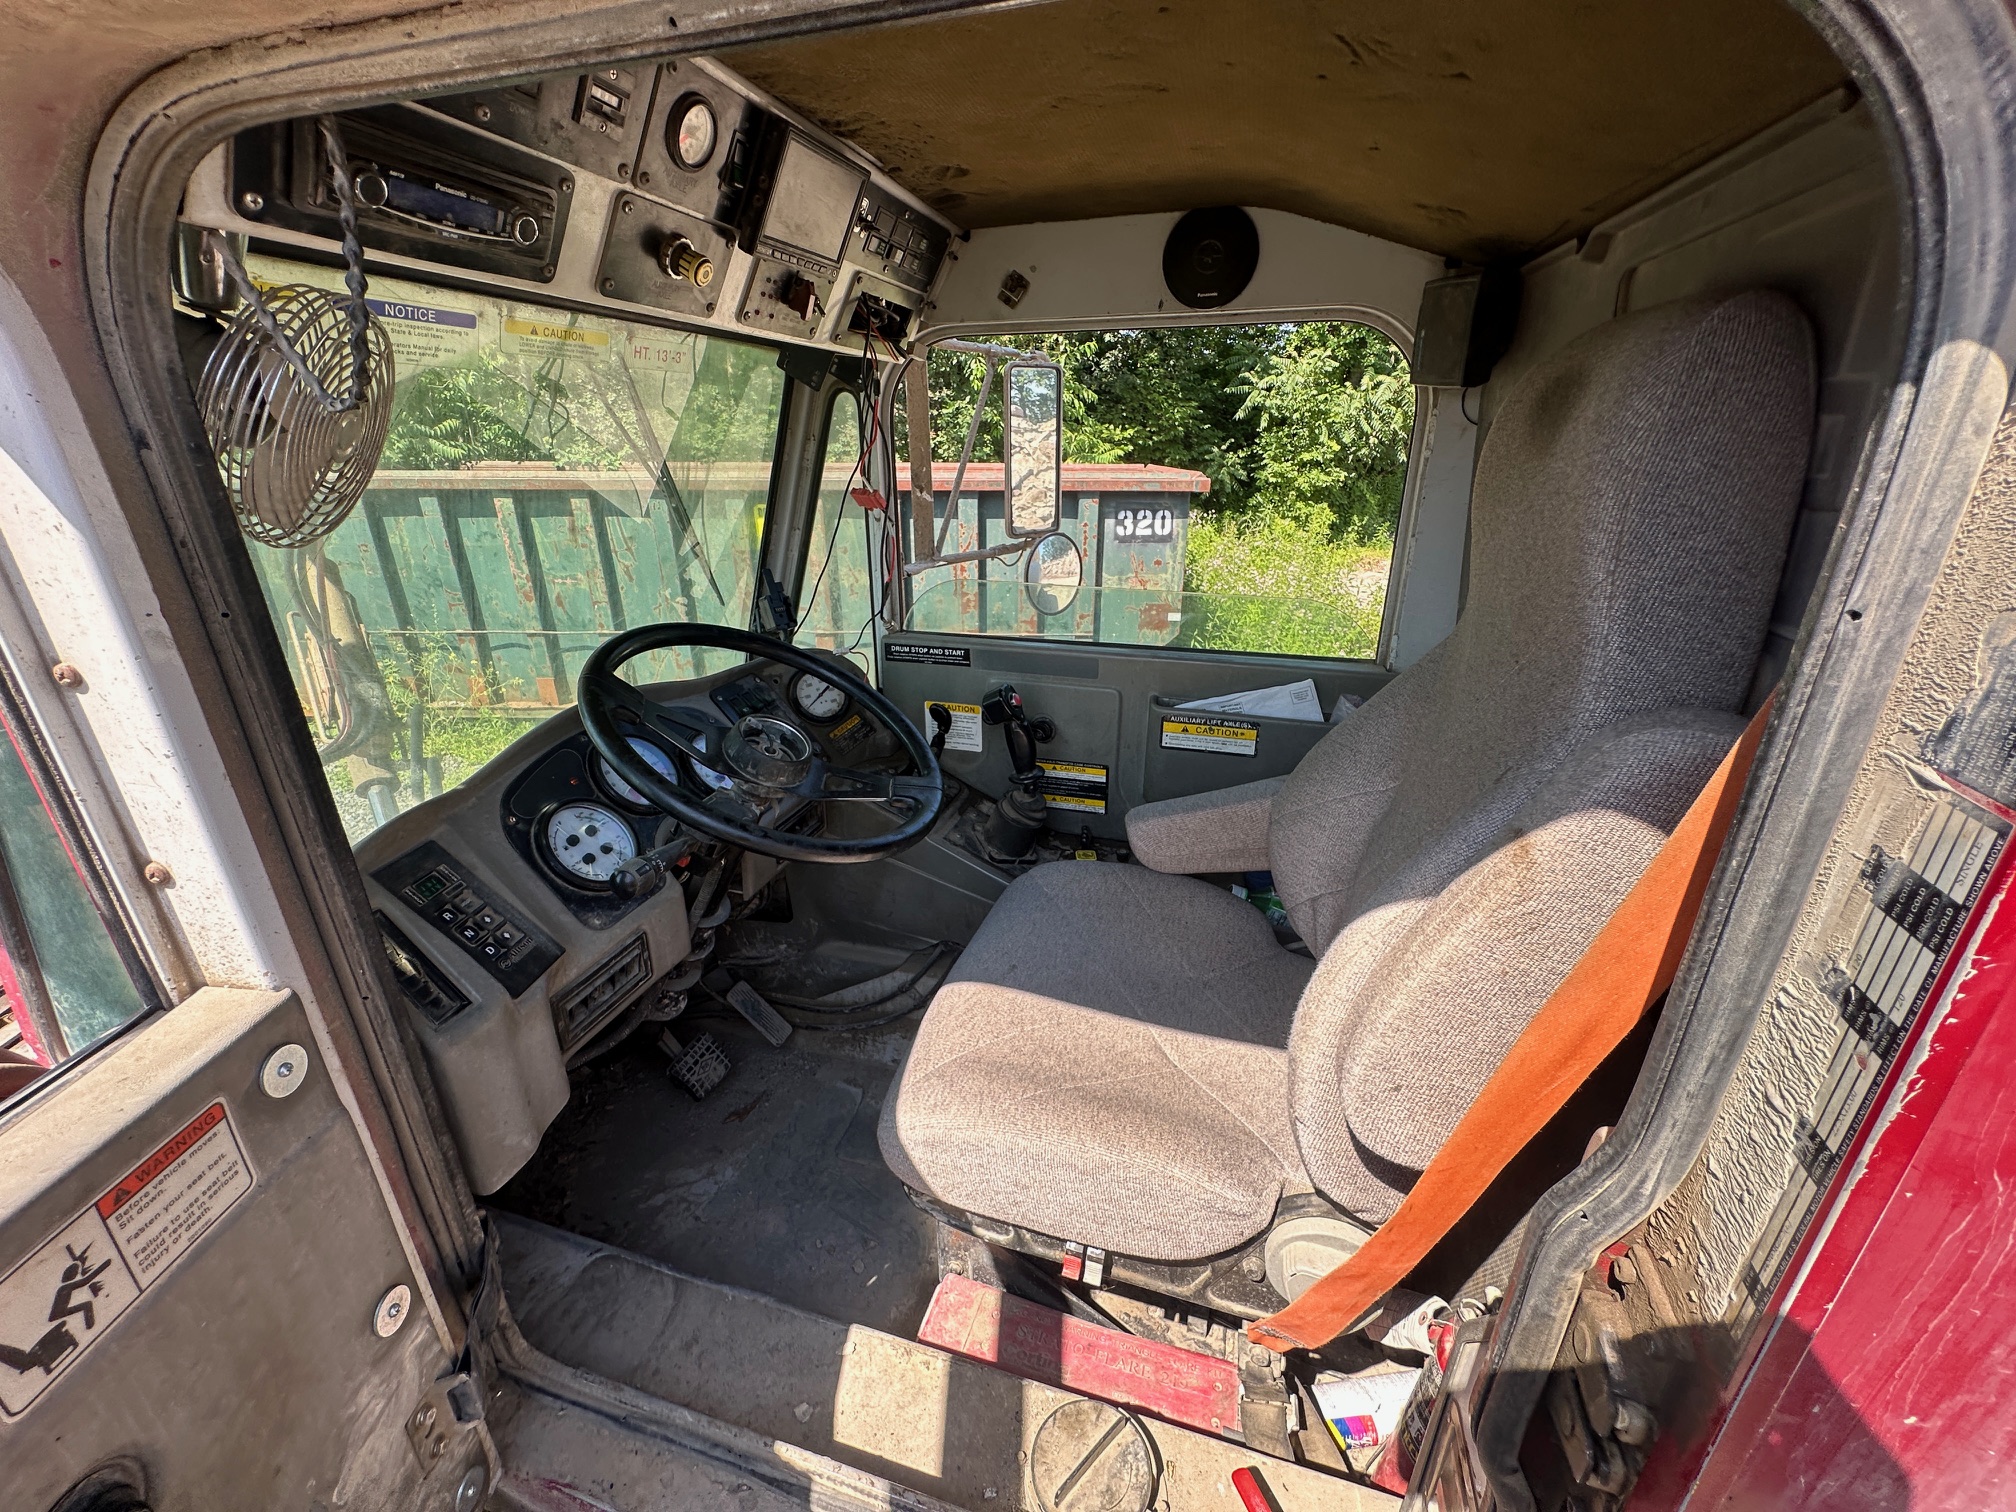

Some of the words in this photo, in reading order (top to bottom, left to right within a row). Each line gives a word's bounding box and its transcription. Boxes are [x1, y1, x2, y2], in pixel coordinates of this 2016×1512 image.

[435, 183, 467, 198] Panasonic
[385, 304, 436, 322] NOTICE
[404, 322, 435, 333] inspection
[436, 326, 462, 337] according
[413, 330, 430, 338] Local
[543, 327, 585, 342] CAUTION
[413, 343, 433, 351] Manual
[634, 346, 650, 360] HT.
[1116, 510, 1172, 536] 320
[1170, 716, 1204, 724] AUXILIARY
[1195, 726, 1239, 737] CAUTION
[1969, 720, 2002, 779] RENDERING
[1992, 731, 2016, 771] DESIGN
[1954, 840, 1984, 887] SINGLE
[1982, 833, 2009, 871] ABOVE.
[1890, 902, 1901, 917] PSI
[1897, 877, 1914, 903] COLD
[1963, 871, 1990, 908] SHOWN
[442, 912, 453, 921] R
[1902, 912, 1915, 928] PSI
[1909, 886, 1927, 912] COLD
[1914, 922, 1927, 939] PSI
[1922, 895, 1940, 922] COLD
[464, 929, 475, 938] N
[1928, 932, 1941, 949] PSI
[1935, 906, 1954, 933] COLD
[1930, 908, 1968, 974] MANUFACTURE
[485, 946, 495, 955] D
[1923, 975, 1934, 988] OF
[1842, 998, 1856, 1018] RIMS
[1892, 993, 1906, 1012] 120
[1911, 989, 1927, 1011] DATE
[1853, 1009, 1867, 1030] RIMS
[1903, 1012, 1915, 1028] THE
[1875, 1032, 1890, 1053] RIMS
[1896, 1029, 1906, 1043] ON
[1878, 1043, 1900, 1076] EFFECT
[1874, 1073, 1884, 1084] IN
[1851, 1084, 1879, 1130] STANDARDS
[135, 1112, 216, 1183] WARNING
[1837, 1128, 1856, 1157] SAFETY
[115, 1191, 150, 1223] Before
[152, 1159, 187, 1190] vehicle
[189, 1129, 220, 1159] moves:
[1810, 1161, 1825, 1181] TIRES
[1822, 1148, 1832, 1159] ON
[1821, 1156, 1841, 1186] VEHICLE
[119, 1215, 134, 1230] Sit
[136, 1188, 167, 1214] down.
[127, 1212, 161, 1245] Fasten
[163, 1190, 184, 1213] your
[187, 1170, 206, 1190] seat
[208, 1152, 227, 1170] belt.
[133, 1226, 169, 1259] Failure
[171, 1214, 181, 1225] to
[183, 1198, 200, 1214] use
[201, 1176, 221, 1196] seat
[222, 1160, 239, 1177] belt
[1808, 1184, 1826, 1212] MOTOR
[138, 1240, 166, 1266] could
[168, 1211, 198, 1238] result
[199, 1201, 206, 1210] in
[208, 1169, 239, 1200] serious
[1793, 1211, 1813, 1242] FEDERAL
[141, 1246, 170, 1273] injury
[172, 1233, 183, 1244] or
[185, 1205, 213, 1233] death.
[1768, 1255, 1790, 1291] APPLICABLE
